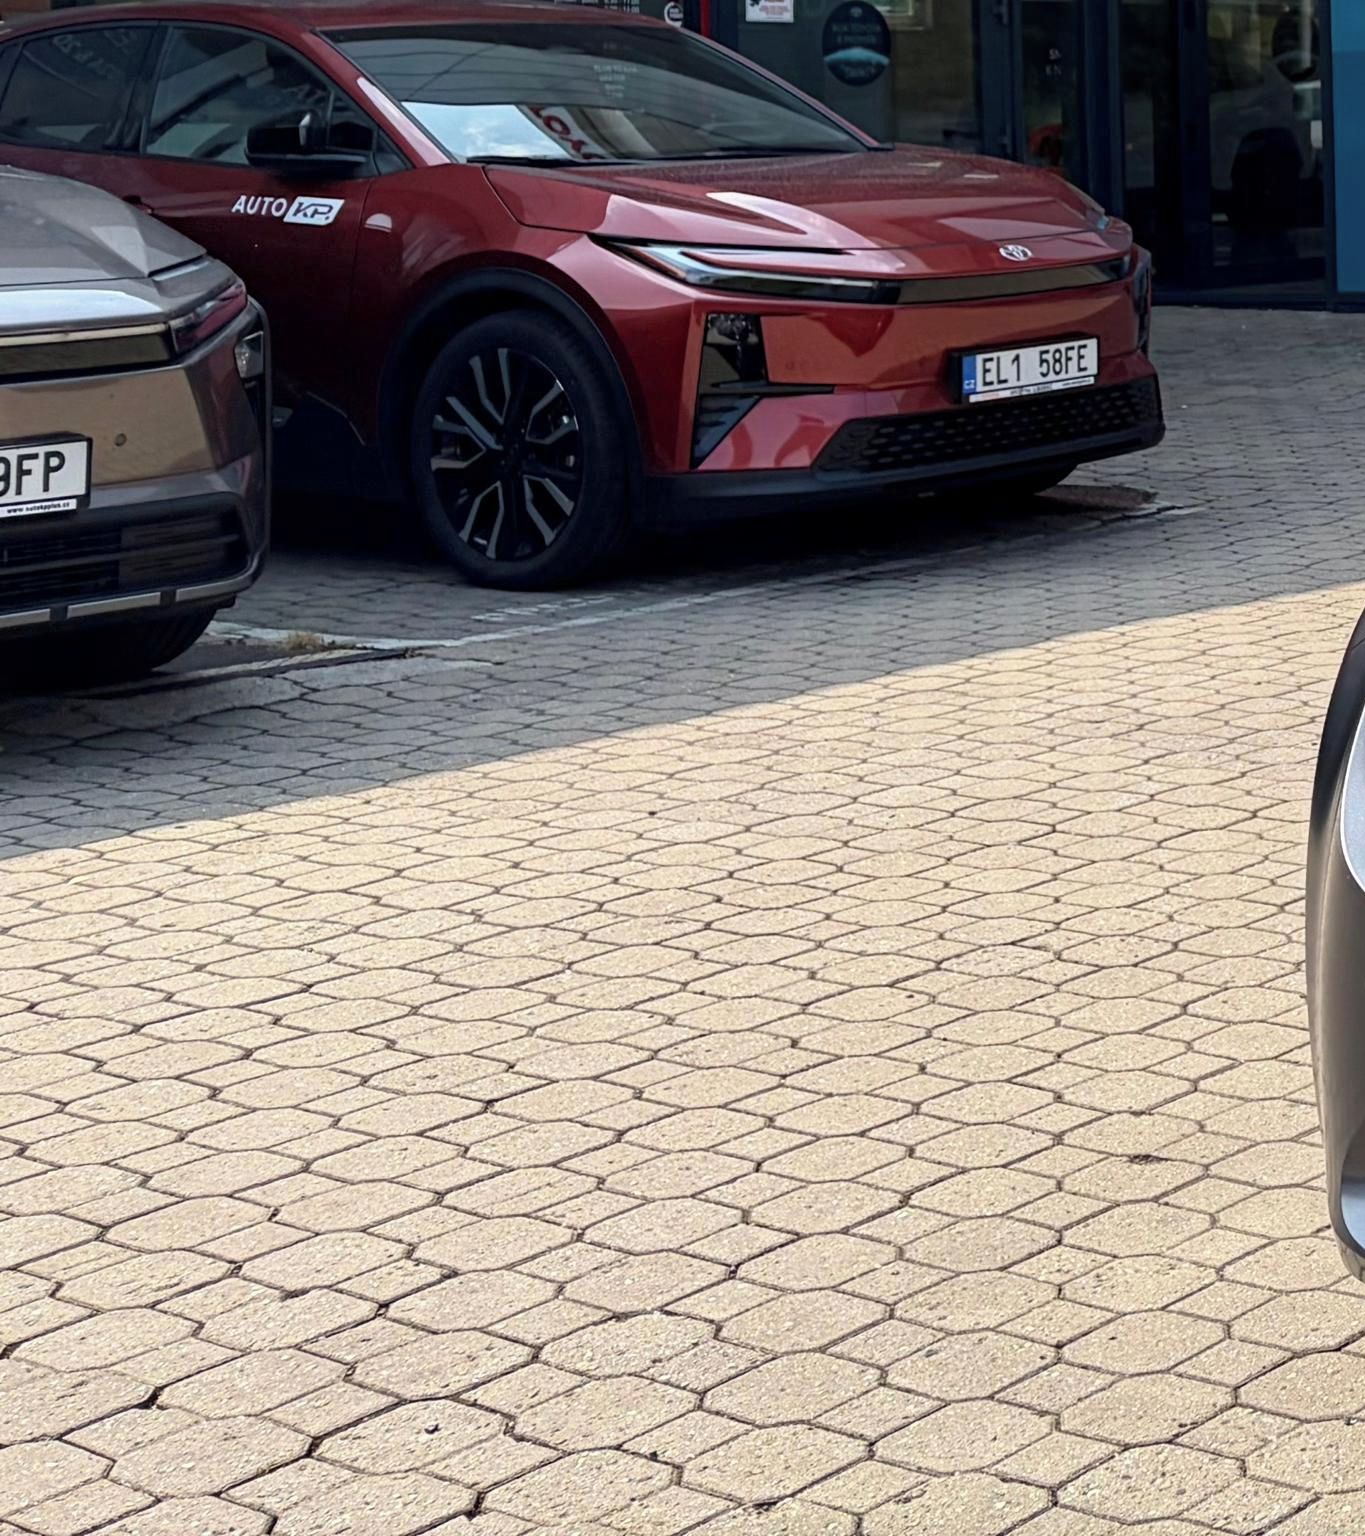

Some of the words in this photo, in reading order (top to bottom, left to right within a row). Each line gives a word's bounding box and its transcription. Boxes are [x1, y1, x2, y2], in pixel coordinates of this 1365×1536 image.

[231, 195, 288, 217] AUTO
[982, 353, 1020, 387] EL1
[1039, 344, 1088, 378] 58FE
